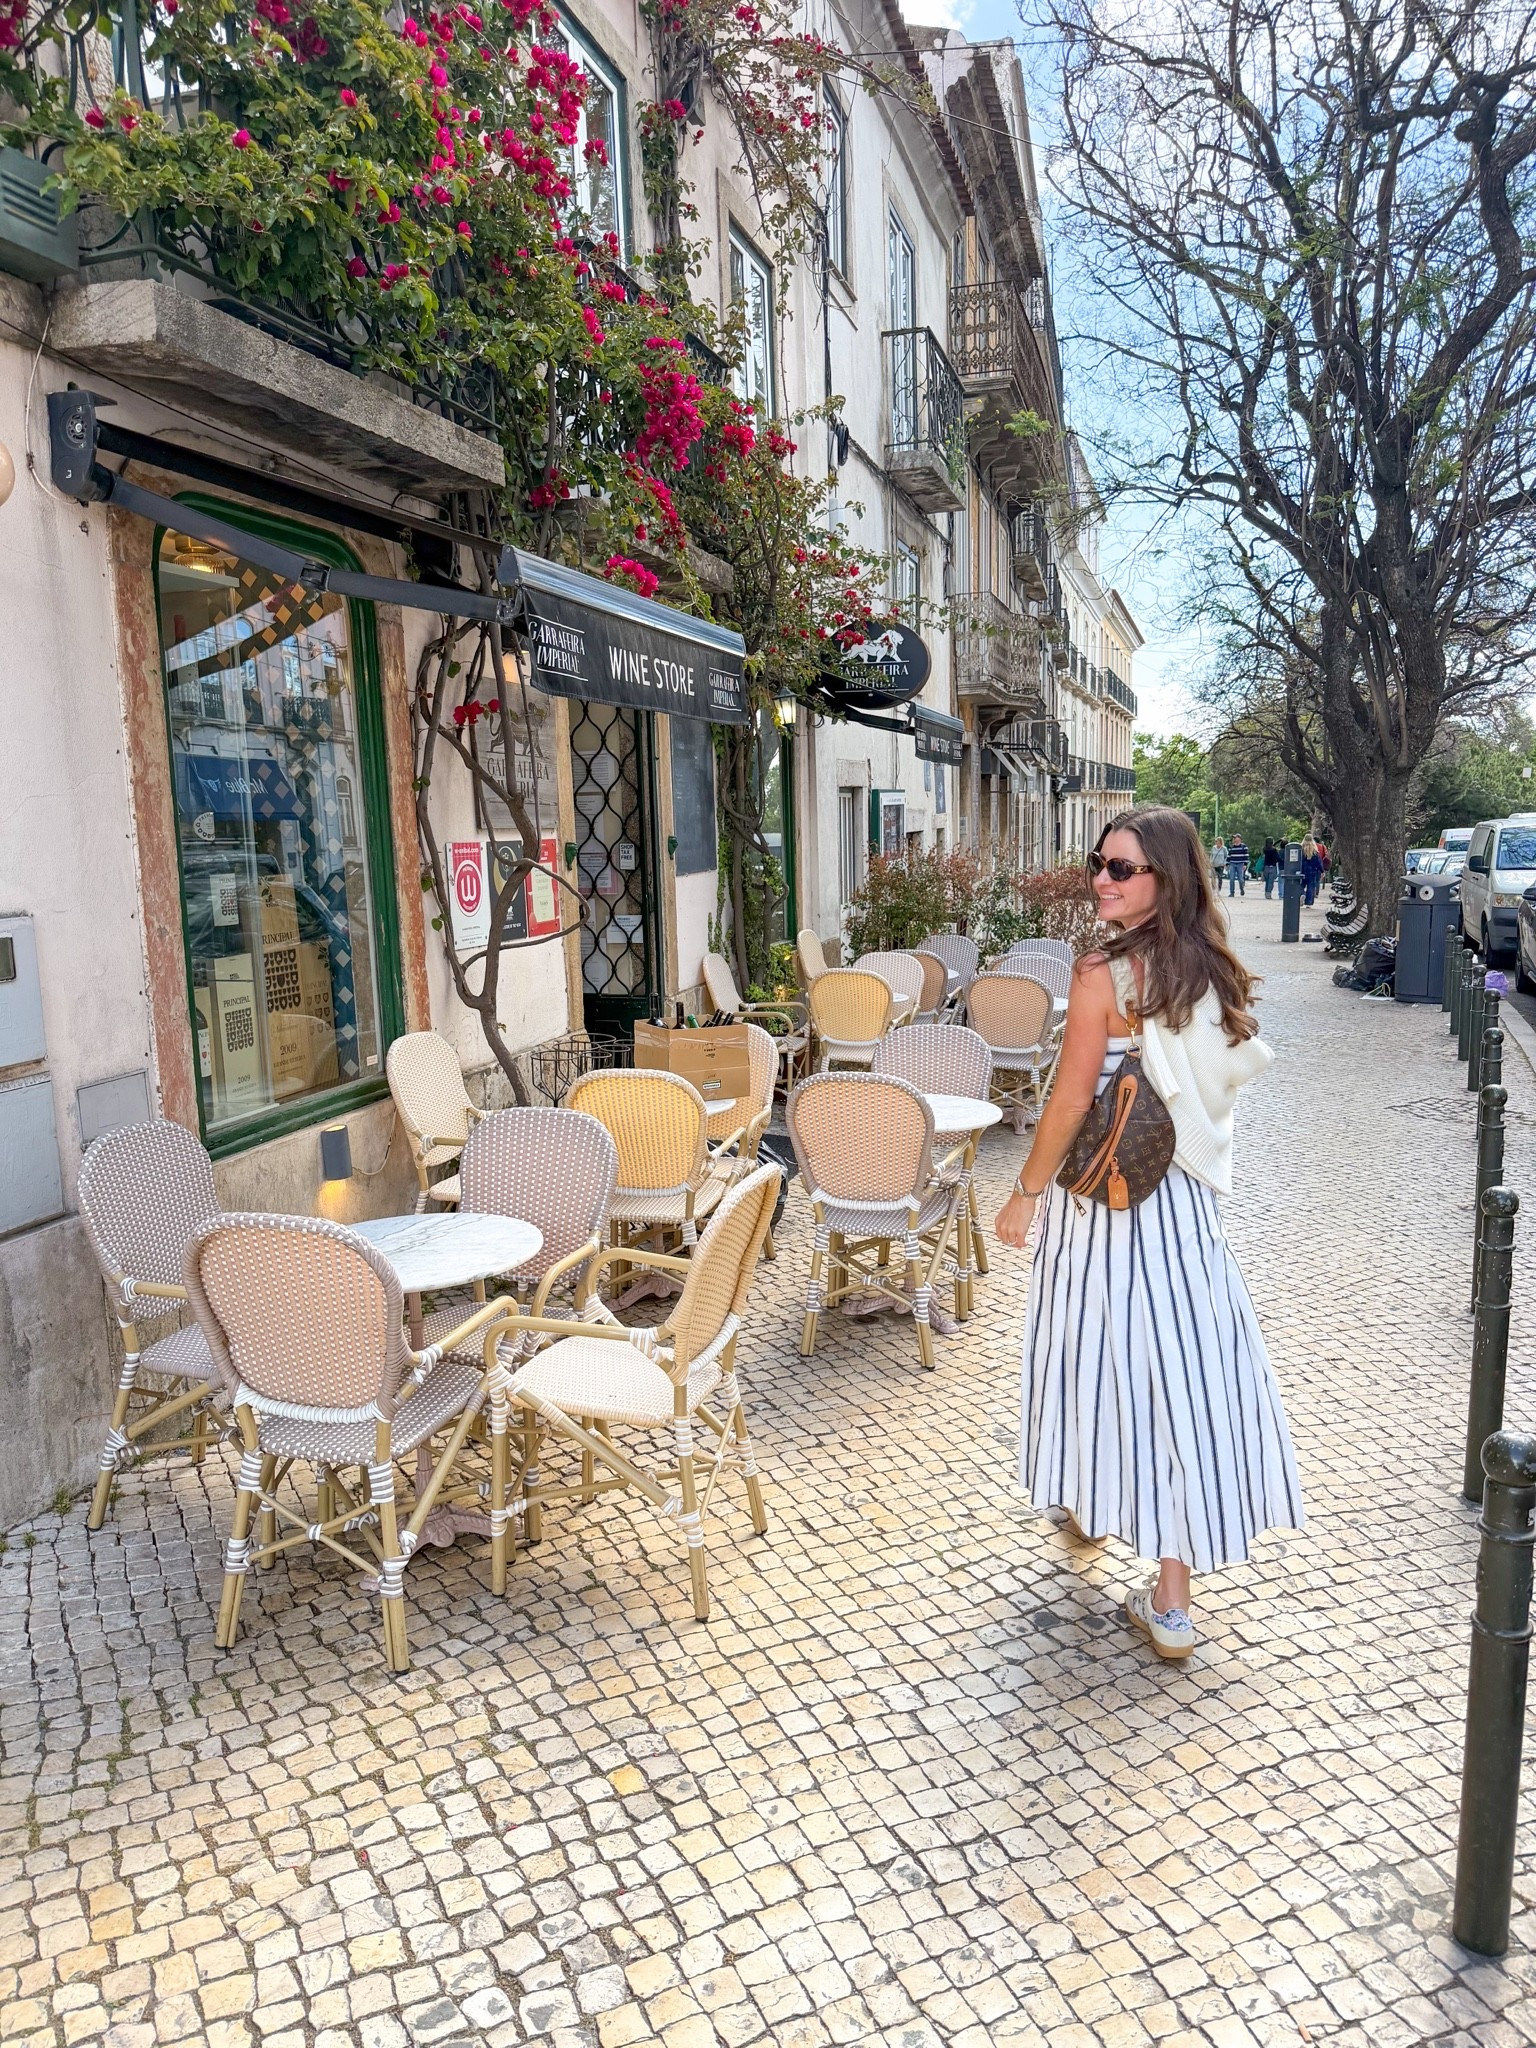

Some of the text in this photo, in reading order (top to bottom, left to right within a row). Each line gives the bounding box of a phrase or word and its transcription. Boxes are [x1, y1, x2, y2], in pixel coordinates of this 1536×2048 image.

[528, 621, 585, 656] GARRAFEIRA
[537, 645, 580, 674] IMPERIAL
[609, 645, 695, 697] WINE STORE
[262, 931, 294, 945] RINCIPAL
[223, 994, 250, 1008] PRINCIPAL
[279, 1042, 297, 1056] 2009
[237, 1073, 251, 1085] 2009
